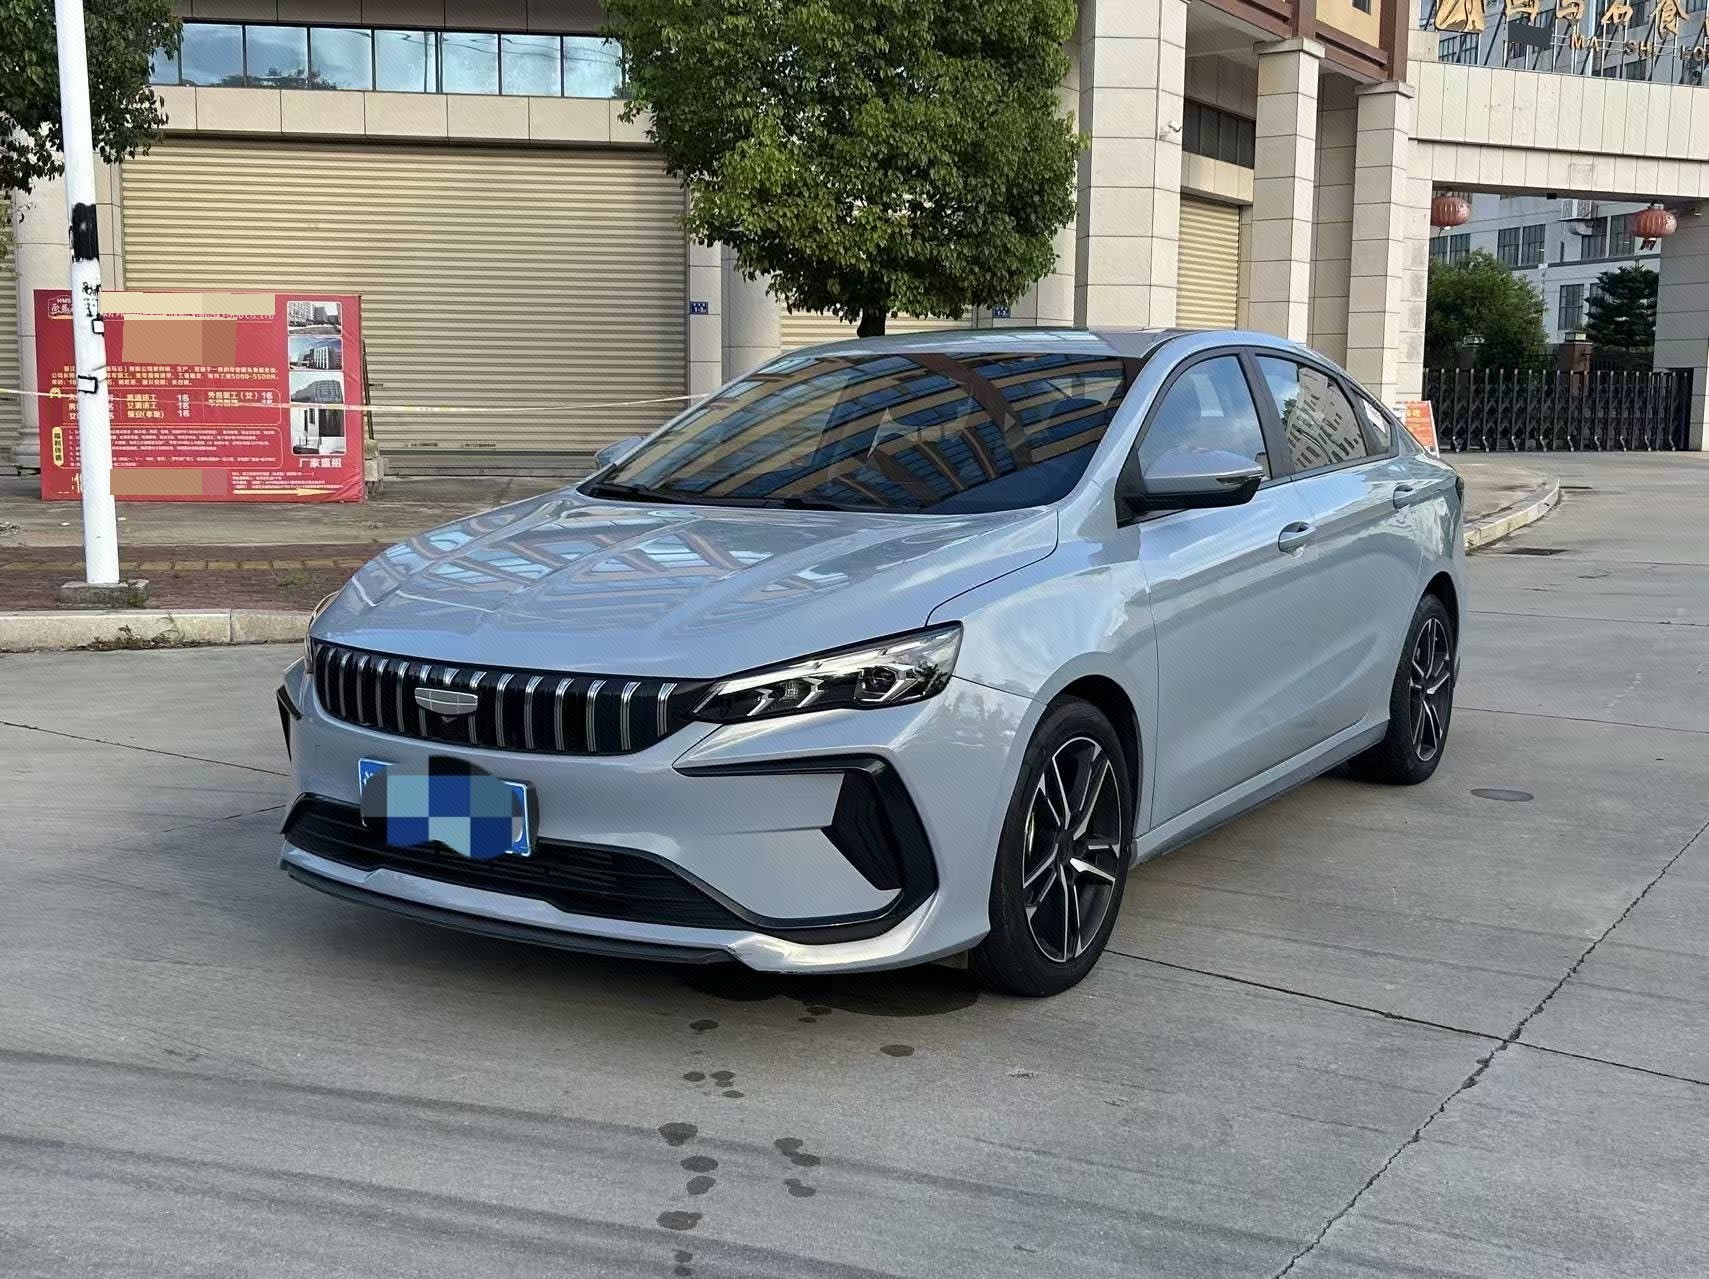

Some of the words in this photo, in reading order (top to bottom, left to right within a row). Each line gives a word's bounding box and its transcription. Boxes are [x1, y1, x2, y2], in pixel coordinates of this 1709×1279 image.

[1570, 34, 1600, 51] MA
[299, 457, 342, 468] 厂家直招
